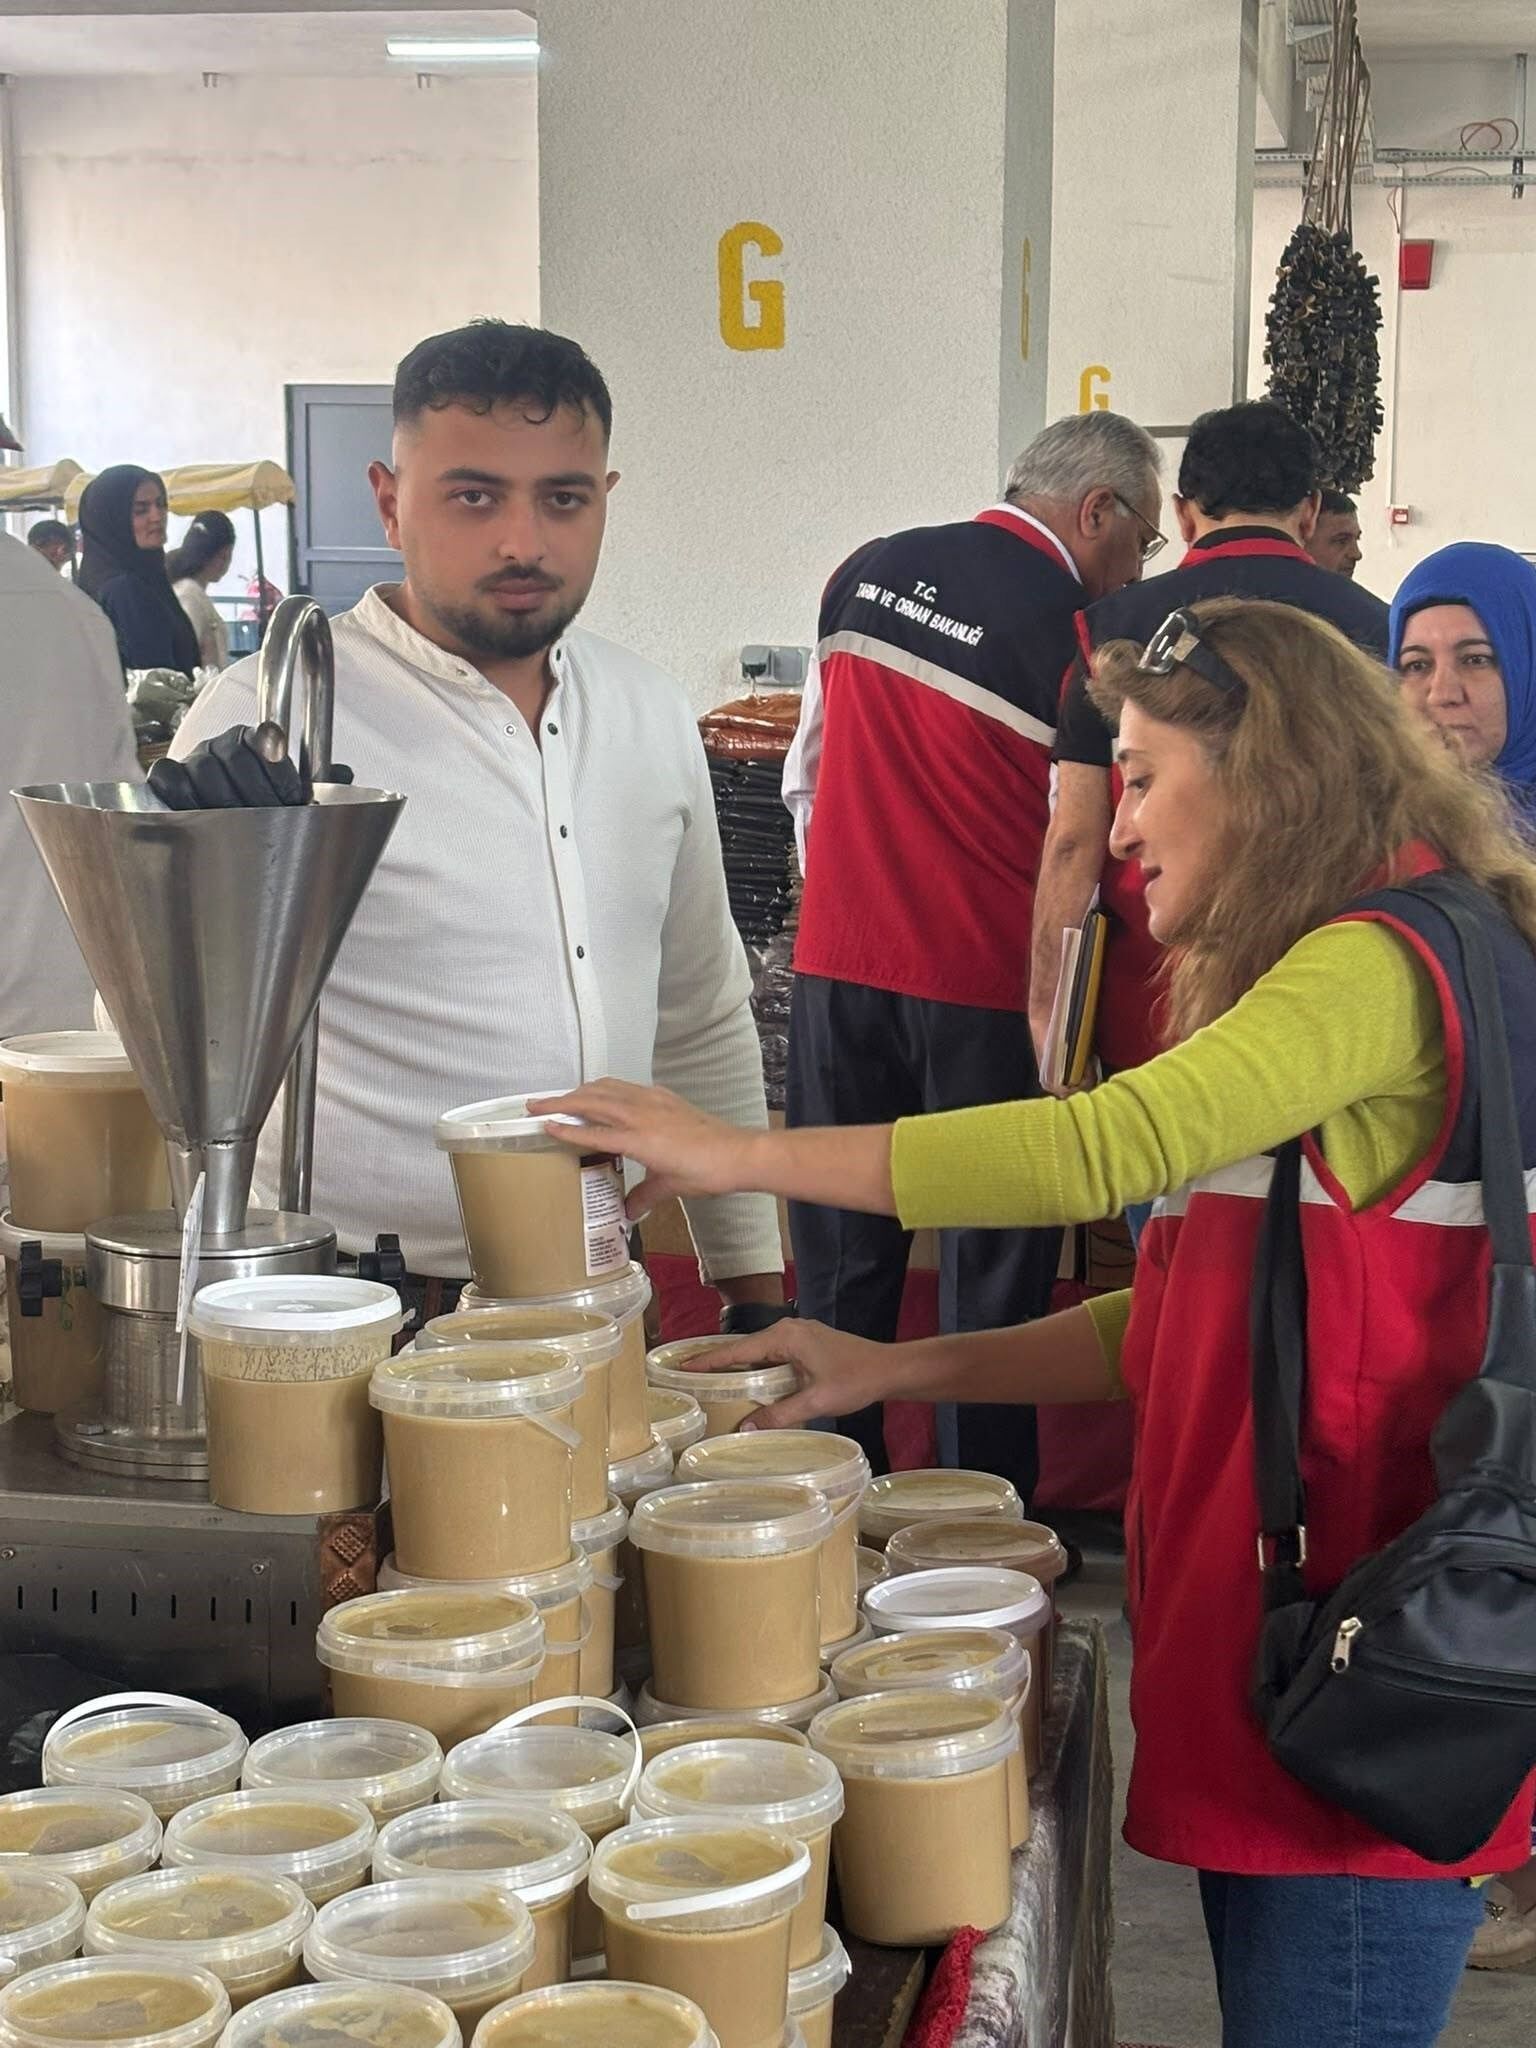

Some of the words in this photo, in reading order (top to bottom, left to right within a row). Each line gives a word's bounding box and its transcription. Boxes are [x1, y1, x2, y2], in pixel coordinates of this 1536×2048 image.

[718, 221, 785, 351] G
[1079, 364, 1111, 416] G
[879, 589, 896, 608] VE
[895, 597, 933, 624] ORMAN
[928, 613, 984, 647] BAKANLIĞI
[913, 580, 937, 602] T.C.
